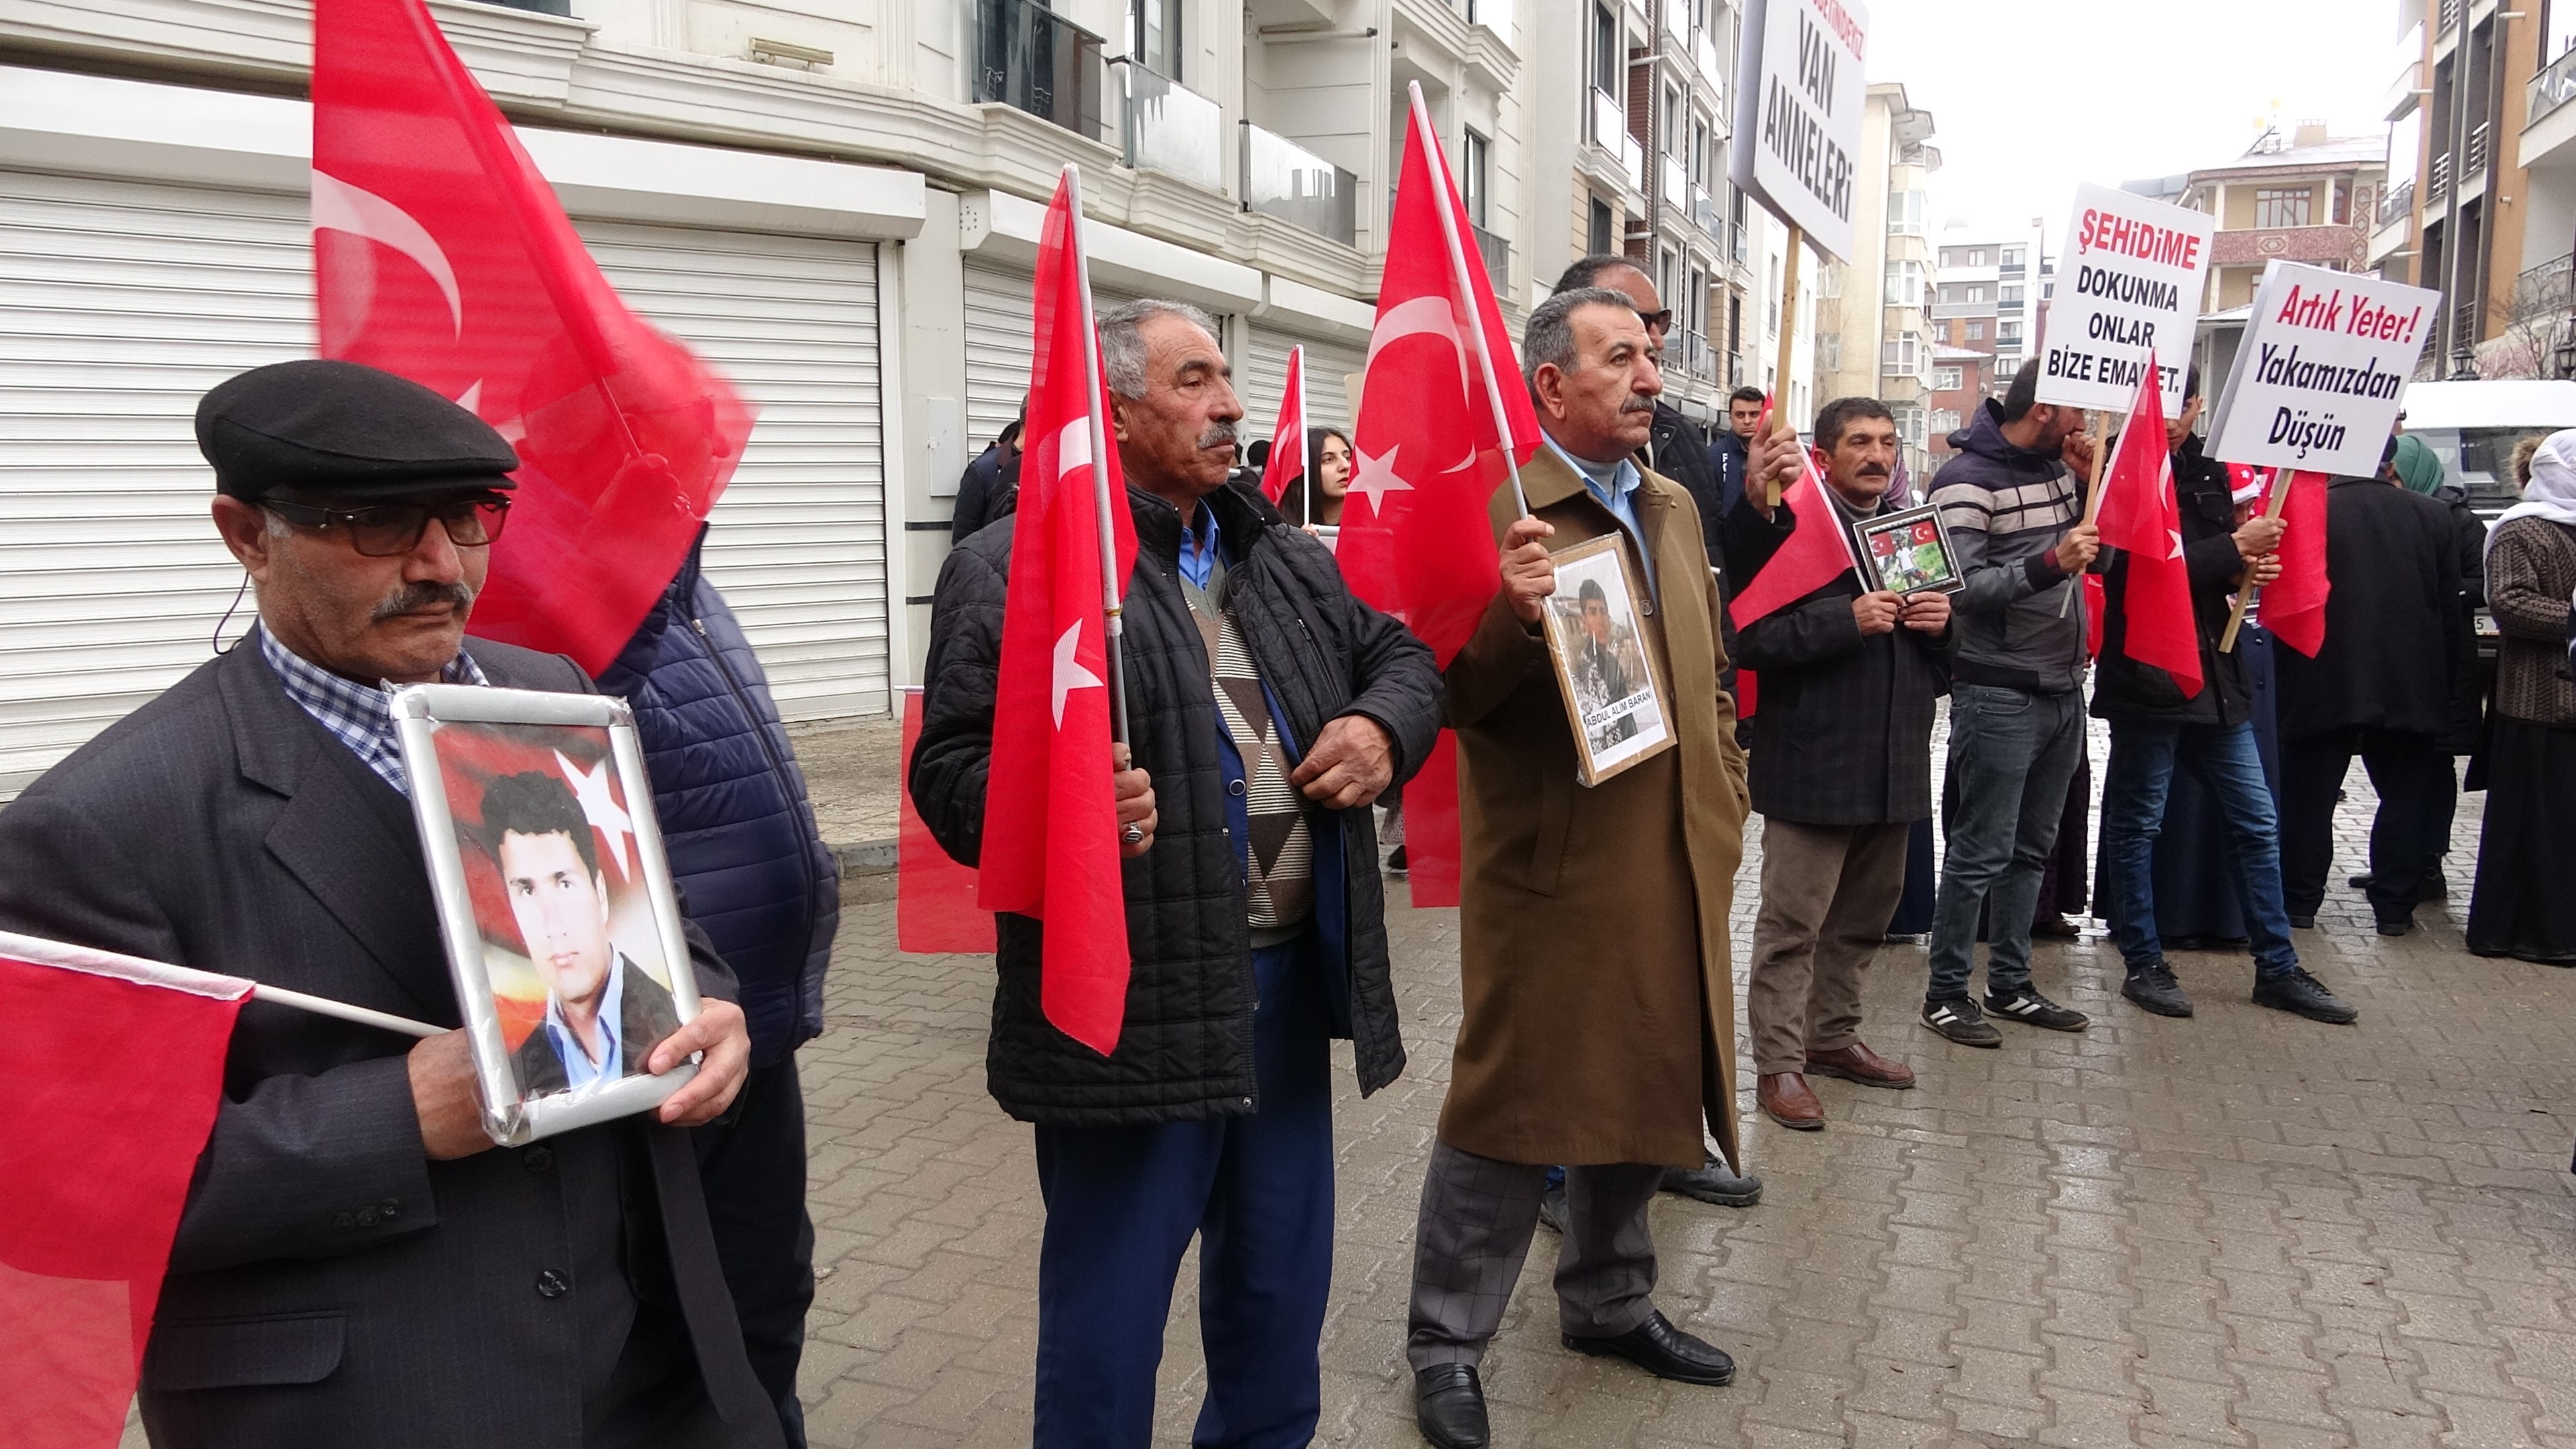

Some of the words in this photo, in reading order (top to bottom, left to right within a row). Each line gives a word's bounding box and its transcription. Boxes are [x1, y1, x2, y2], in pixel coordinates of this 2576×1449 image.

[1800, 7, 1836, 119] VAN
[2077, 265, 2178, 312] DOKUNMA
[2088, 312, 2155, 348] ONLAR
[2277, 284, 2343, 332] Artık
[2346, 294, 2422, 344] Yeter!
[2047, 344, 2093, 380] BİZE
[2097, 357, 2179, 393] EMAET.
[2255, 343, 2401, 400] Yakamızdan
[2267, 407, 2347, 459] Düşün
[1587, 710, 1611, 726] ABDUL
[1627, 691, 1651, 708] BARAN
